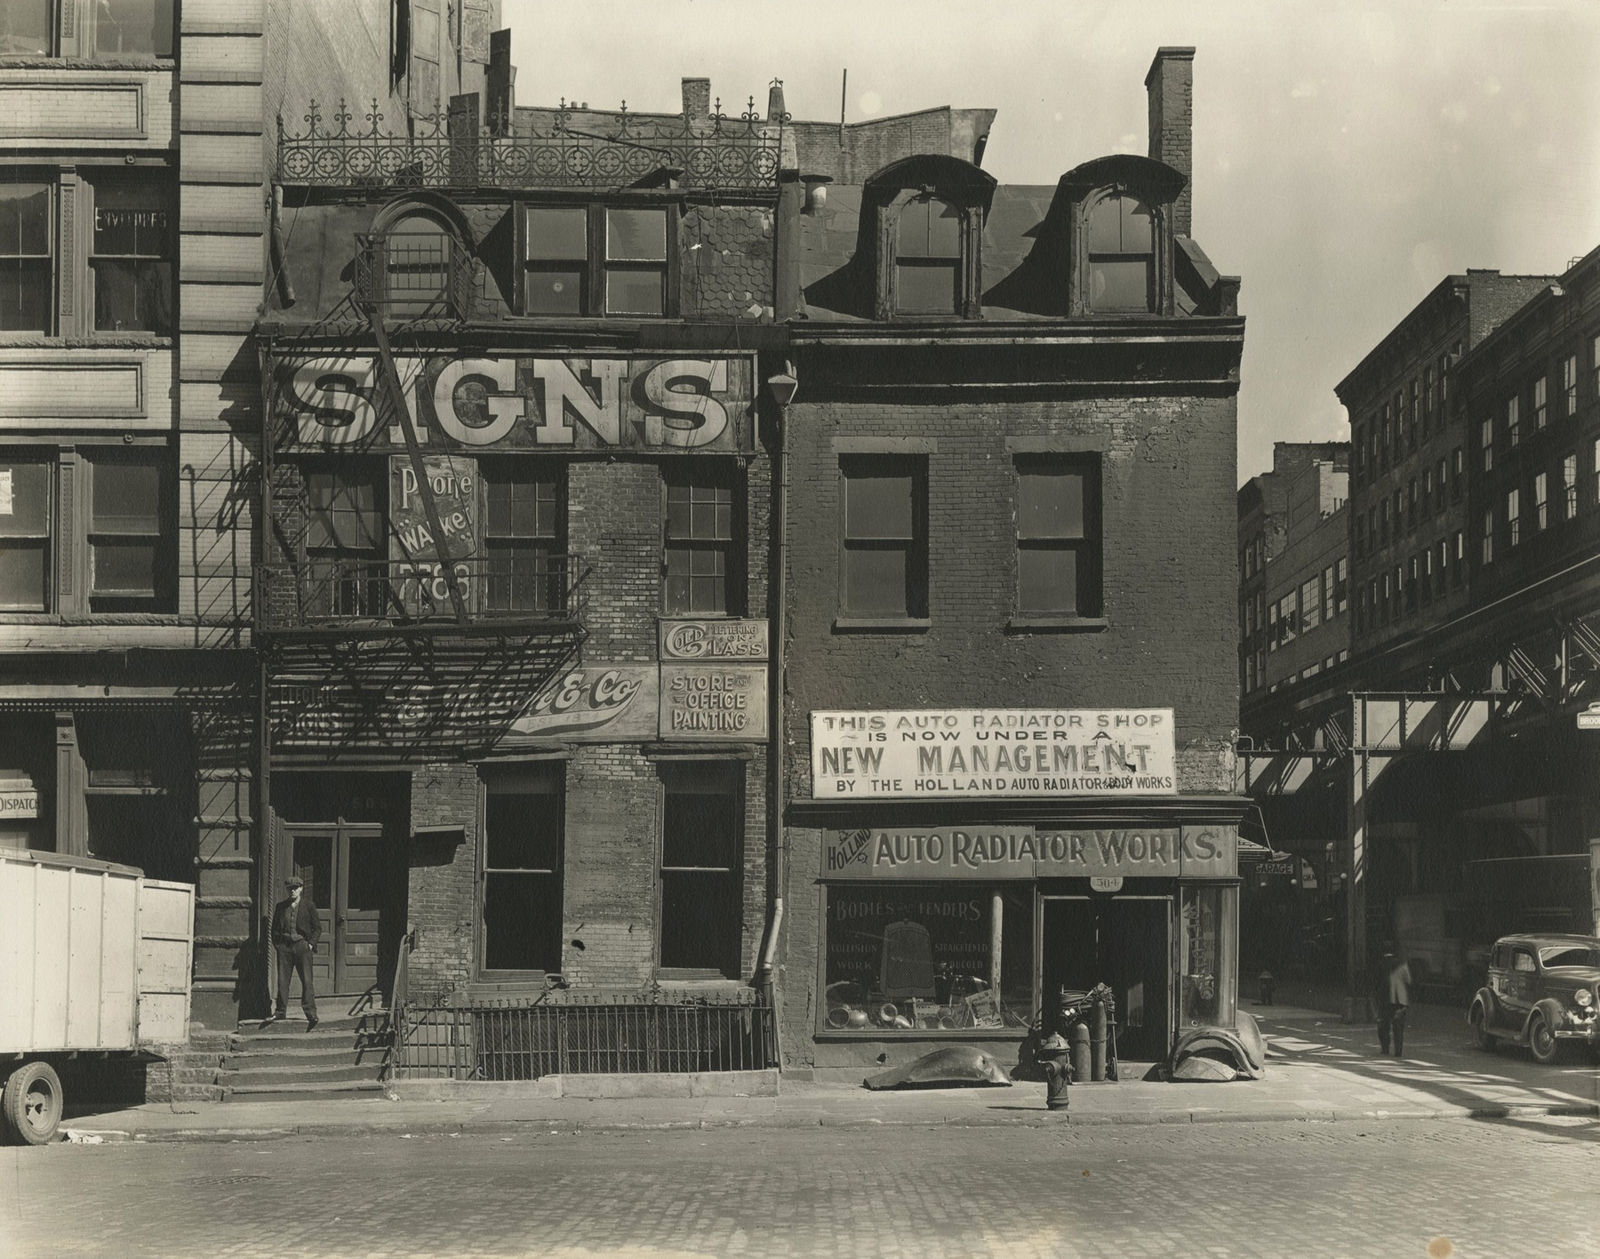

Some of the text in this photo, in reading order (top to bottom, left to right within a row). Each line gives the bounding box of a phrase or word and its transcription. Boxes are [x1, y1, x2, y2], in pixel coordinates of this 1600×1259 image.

[287, 357, 728, 446] SIGNS
[401, 467, 473, 509] Pone
[670, 675, 734, 692] STORE
[686, 693, 746, 710] OFFICE
[671, 710, 747, 731] PAINTING
[822, 713, 1162, 730] THIS AUTO RADIATOR SHOP
[868, 730, 1112, 742] IS NOW UNDER A
[820, 744, 1152, 777] NEW MANAGEMENT
[836, 780, 856, 792] BY
[871, 779, 903, 791] THE
[914, 778, 1006, 791] HOLLAND
[1011, 777, 1040, 790] AUTO
[1043, 777, 1102, 790] RADIATOR
[1135, 776, 1173, 789] WORKS
[828, 828, 872, 870] HOLLAND
[873, 830, 1224, 869] AUTO RADIATOR WORKS.
[1255, 863, 1292, 874] GARAGE
[836, 900, 895, 920] BODIES
[919, 899, 982, 920] FENDERS
